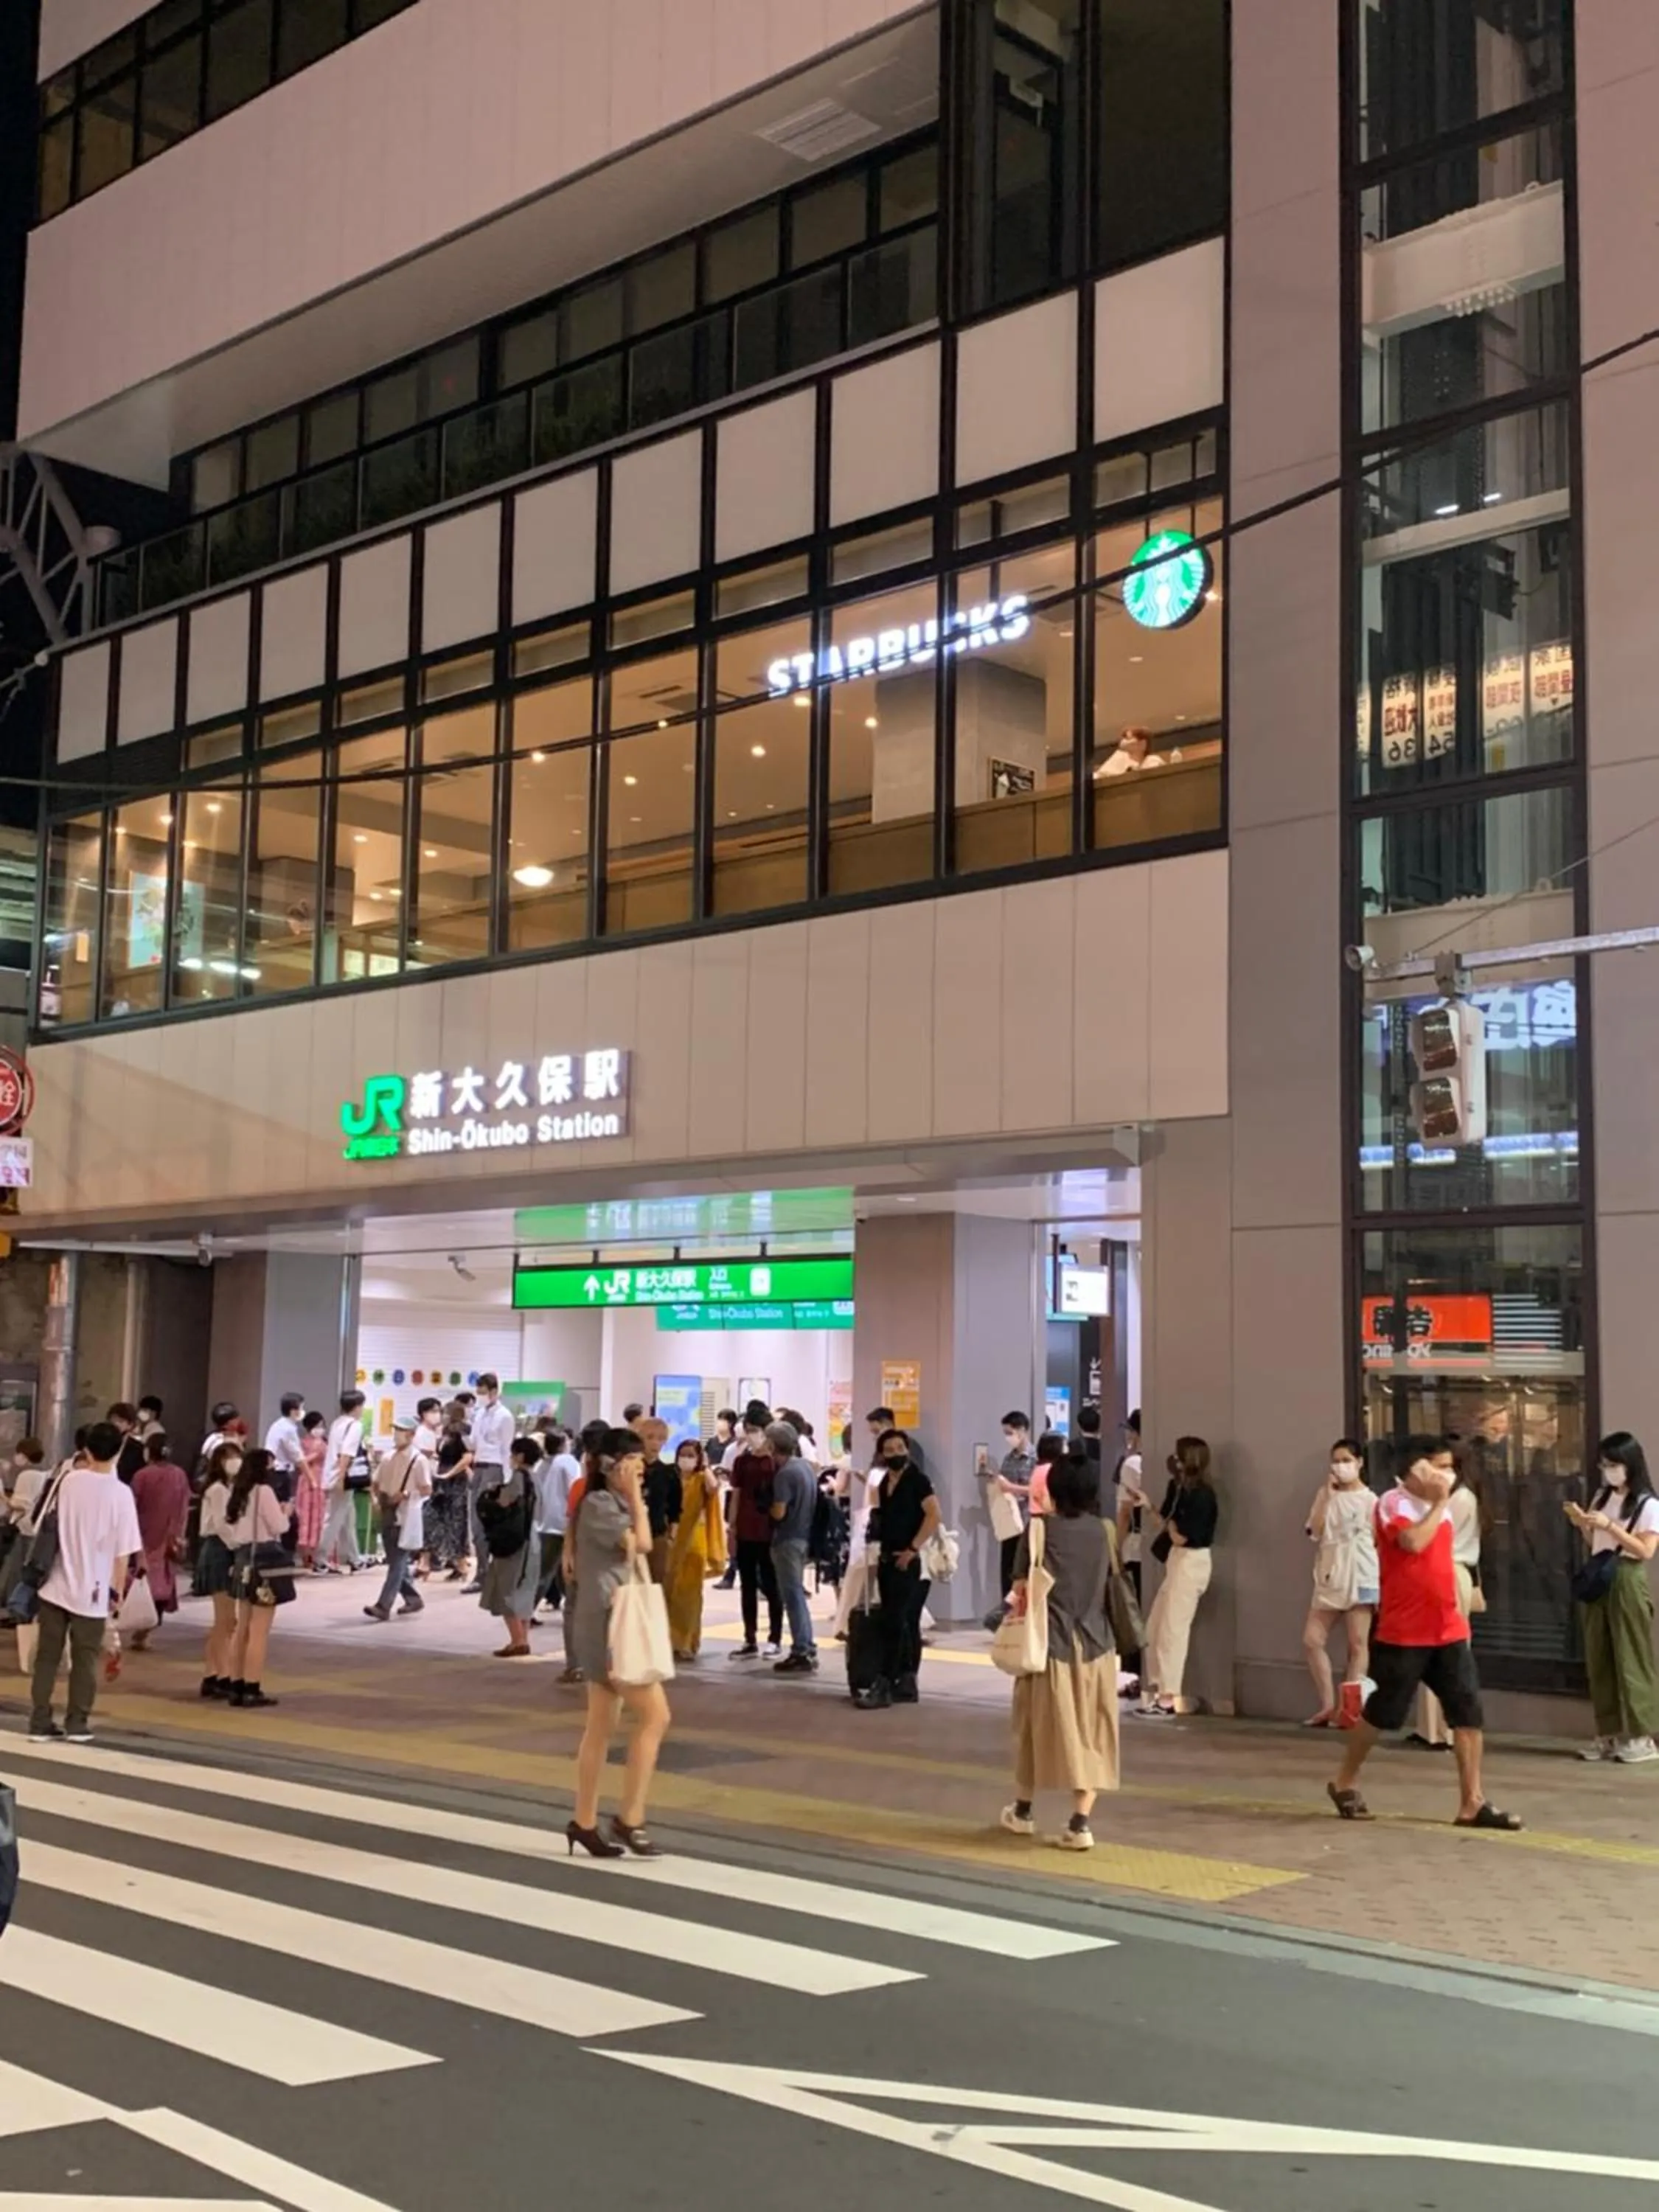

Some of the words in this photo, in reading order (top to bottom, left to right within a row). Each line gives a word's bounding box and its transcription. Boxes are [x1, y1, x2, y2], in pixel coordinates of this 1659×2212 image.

[341, 1074, 404, 1134] JR
[410, 1048, 619, 1119] 新大久保駅
[408, 1119, 529, 1155] Shin-Ōkubo
[537, 1111, 619, 1143] Station
[603, 1270, 631, 1294] JR
